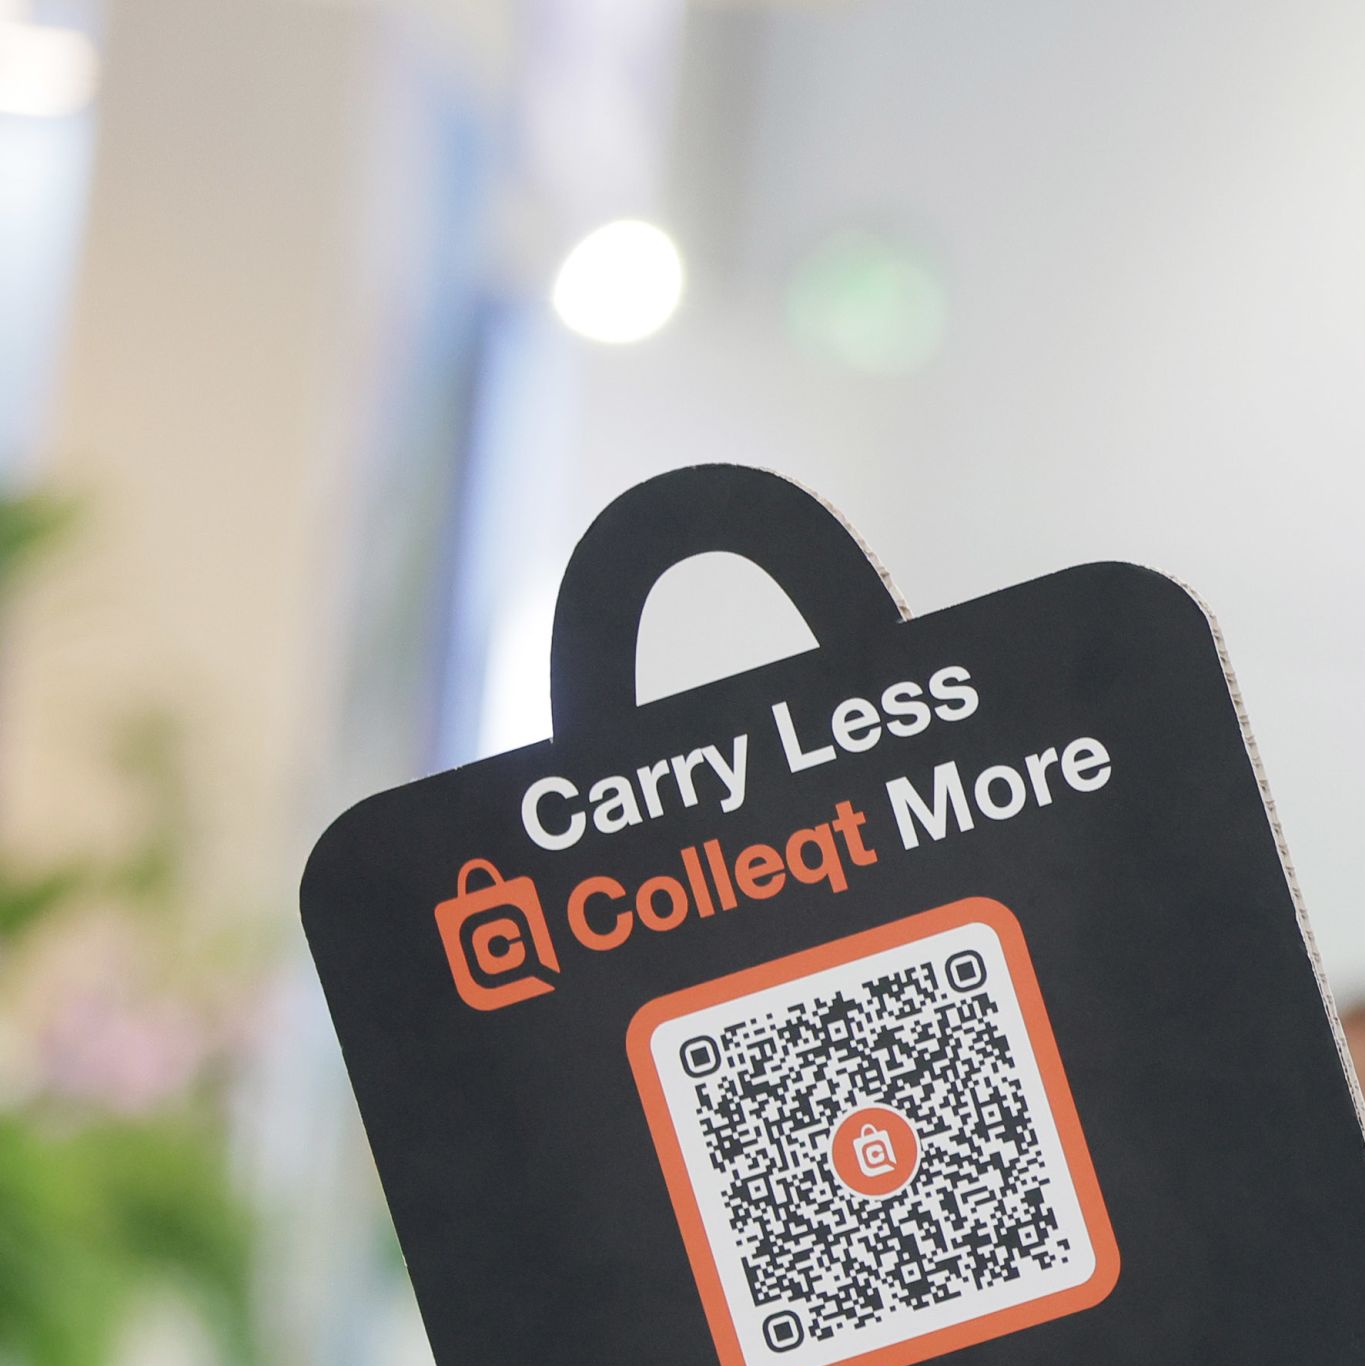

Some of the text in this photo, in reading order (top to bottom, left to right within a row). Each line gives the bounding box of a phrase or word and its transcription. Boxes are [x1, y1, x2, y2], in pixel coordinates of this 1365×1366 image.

[521, 665, 980, 852] Carry Less
[567, 737, 1112, 951] Colleqt More
